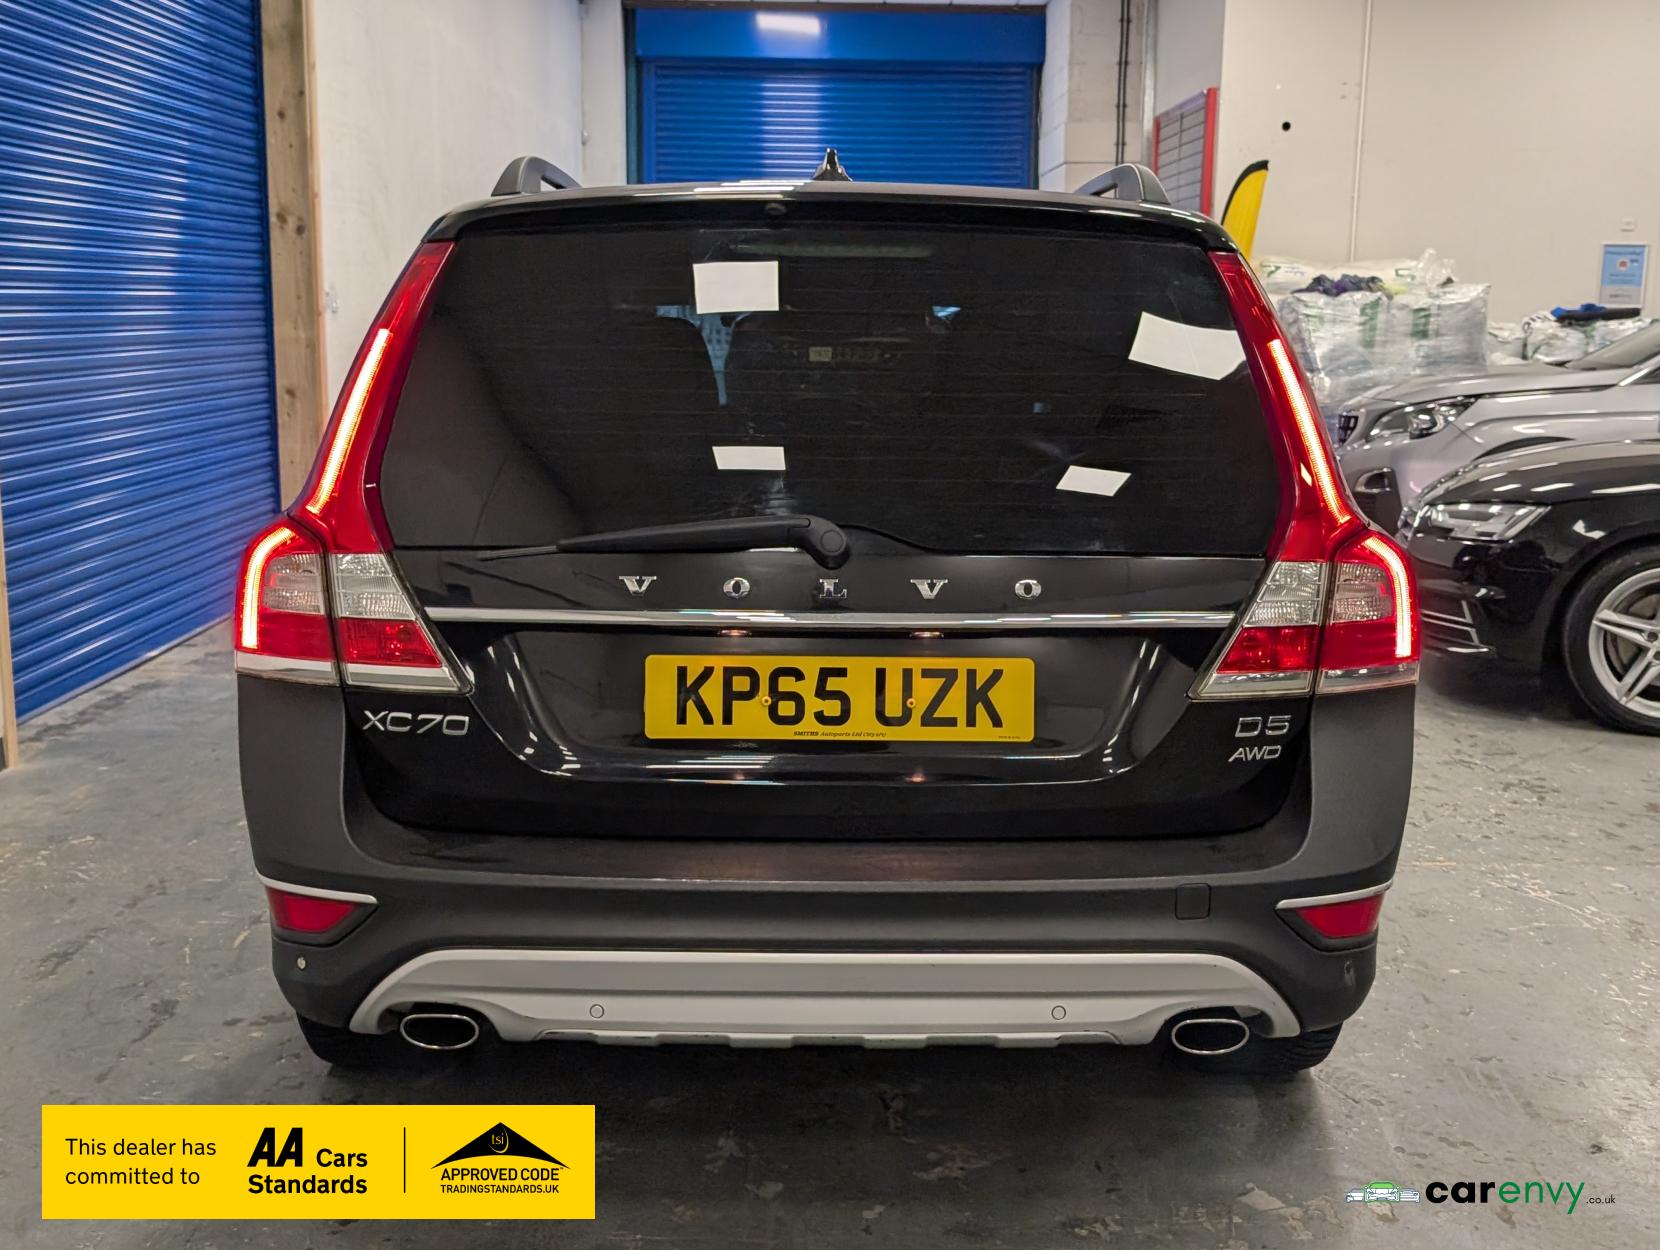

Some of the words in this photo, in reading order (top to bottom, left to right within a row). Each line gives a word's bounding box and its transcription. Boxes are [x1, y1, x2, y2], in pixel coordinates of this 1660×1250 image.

[618, 575, 1043, 600] VOLVO
[676, 665, 852, 727] KP65
[875, 667, 1005, 728] UZK
[362, 710, 470, 736] XC70
[1234, 715, 1292, 738] D5
[1228, 745, 1282, 763] AWD
